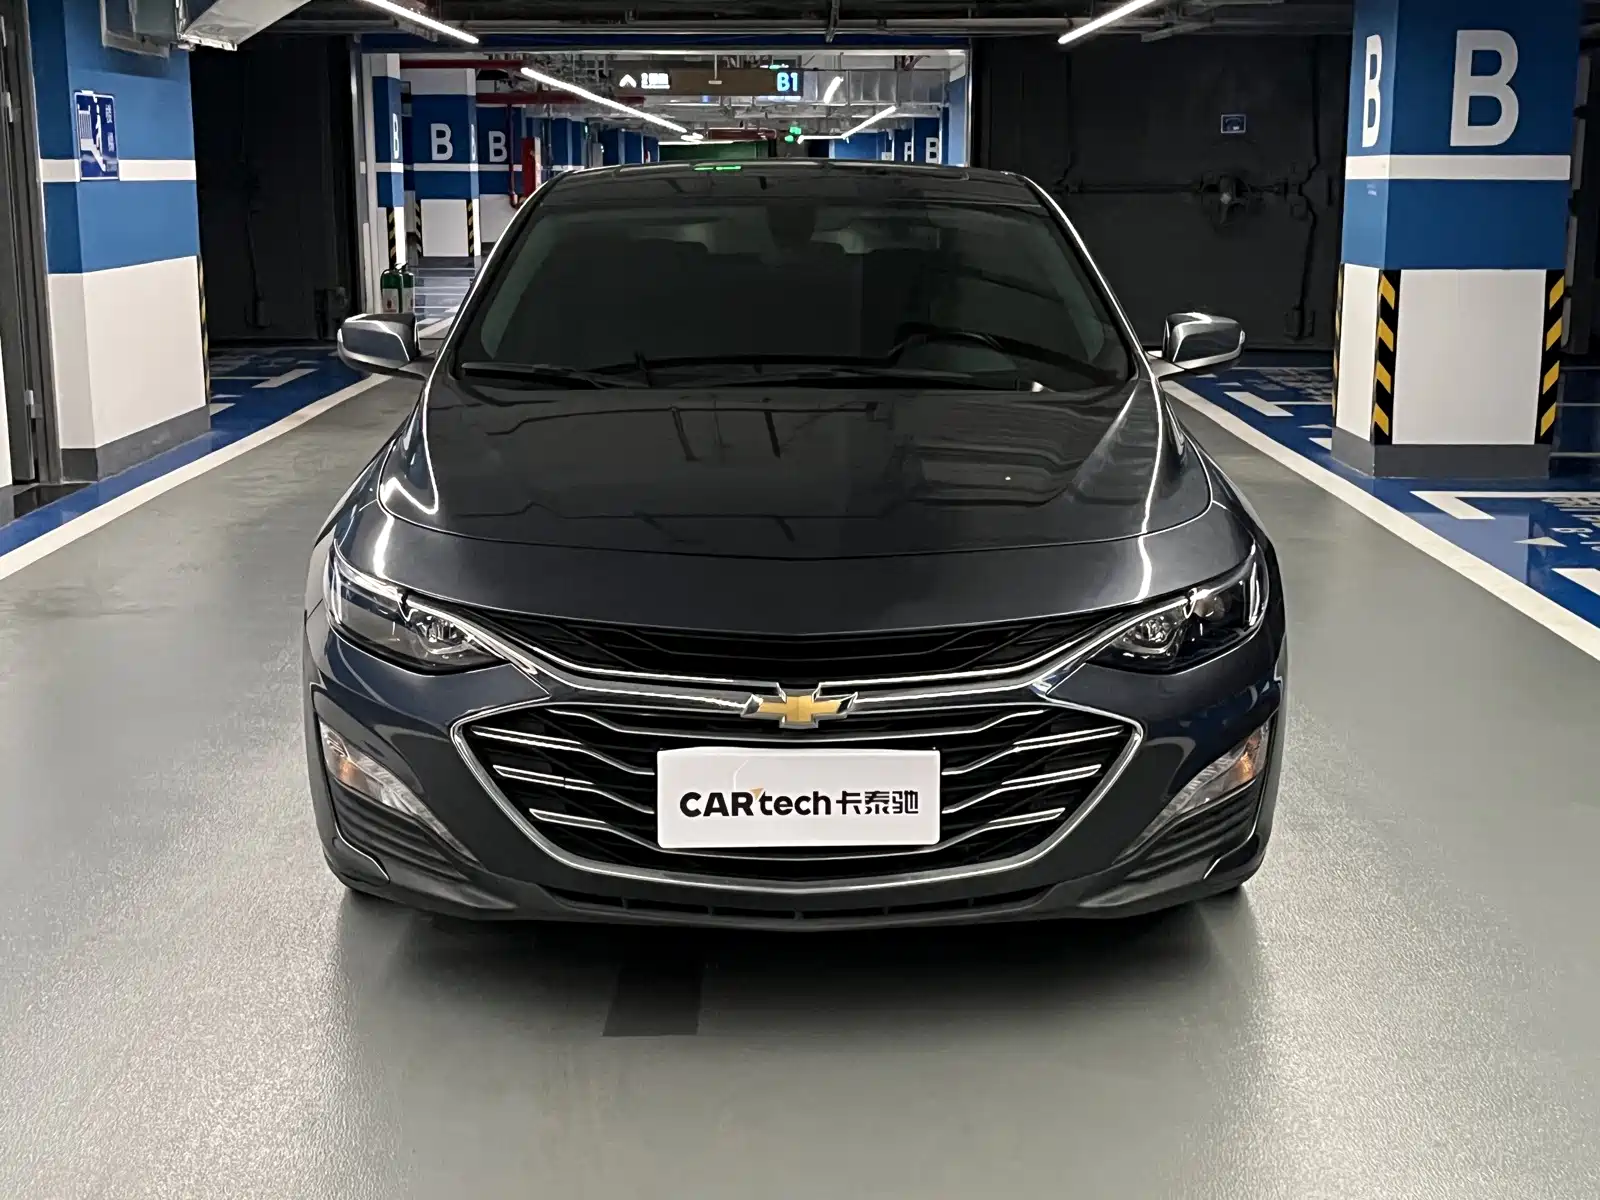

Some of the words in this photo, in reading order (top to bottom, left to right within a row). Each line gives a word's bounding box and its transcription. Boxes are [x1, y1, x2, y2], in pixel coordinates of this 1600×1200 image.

[776, 72, 798, 92] B1
[1362, 34, 1383, 148] B
[1450, 29, 1520, 147] B
[392, 113, 399, 160] B
[430, 123, 454, 161] B
[488, 131, 507, 162] B
[925, 136, 940, 164] B
[679, 789, 832, 818] CARtech
[835, 790, 919, 815] 卡泰驰
